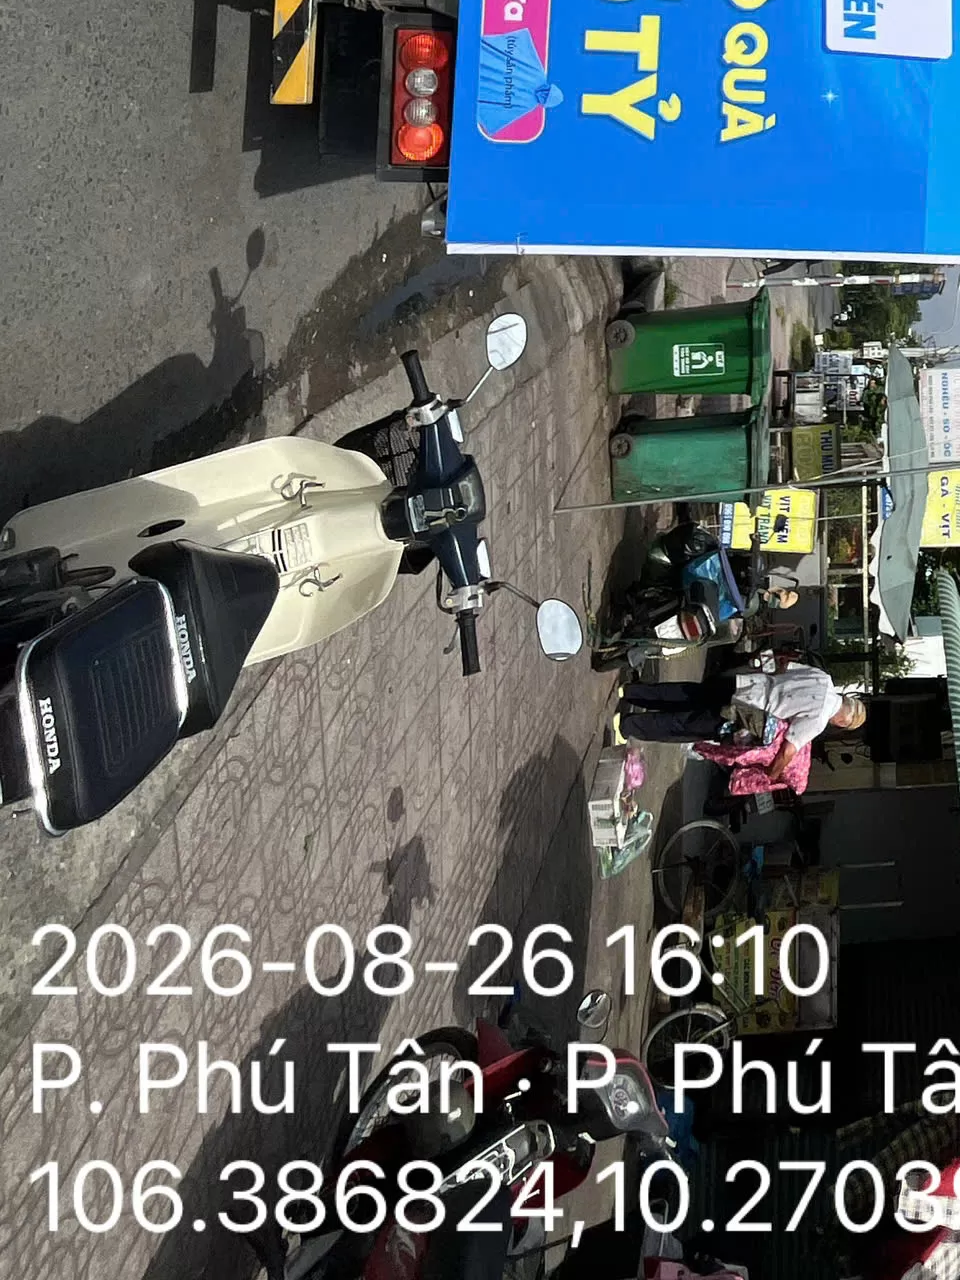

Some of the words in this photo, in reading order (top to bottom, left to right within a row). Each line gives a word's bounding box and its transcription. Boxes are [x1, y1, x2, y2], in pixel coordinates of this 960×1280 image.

[581, 16, 680, 140] TỶ
[720, 23, 775, 142] QUÀ
[776, 496, 791, 512] VỊT
[939, 514, 950, 539] VỊT
[174, 614, 197, 684] HONDA
[38, 697, 61, 775] HONDA
